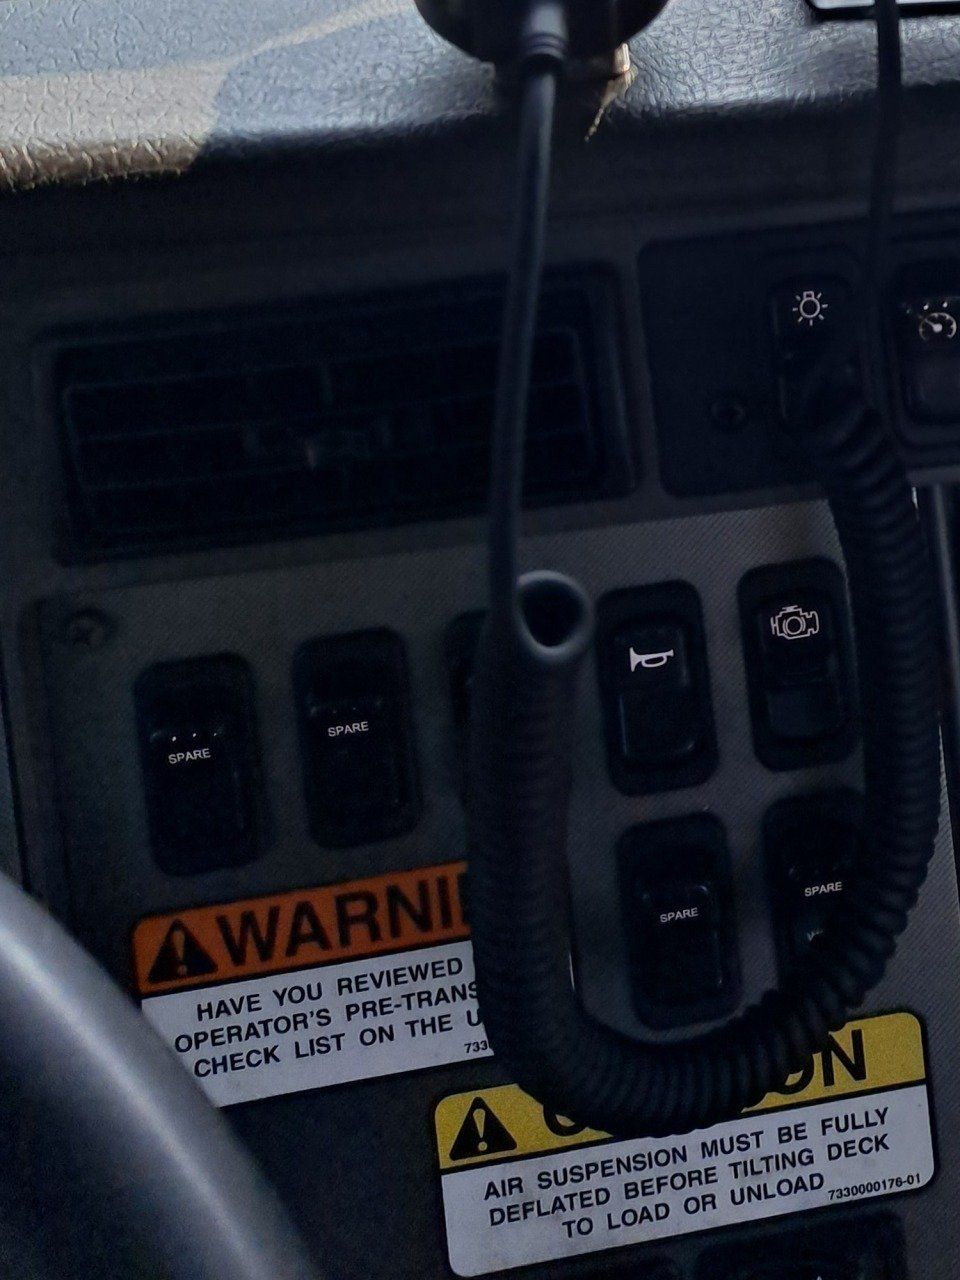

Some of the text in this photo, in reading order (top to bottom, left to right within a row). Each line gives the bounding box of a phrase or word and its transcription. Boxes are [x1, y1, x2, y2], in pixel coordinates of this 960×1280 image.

[327, 720, 370, 738] SPARE
[168, 747, 212, 765] SPARE
[804, 880, 843, 898] SPARE
[659, 906, 699, 923] SPARE
[196, 957, 464, 1021] HAVE YOU REVIEWED
[174, 1007, 333, 1054] OPERATOR'S
[193, 1045, 281, 1078] CHECK
[294, 1033, 346, 1060] LIST
[359, 1024, 396, 1047] ON
[405, 1014, 454, 1039] THE
[484, 1106, 889, 1202] AIR SUSPENSION MUST BE FULLY
[489, 1133, 890, 1228] DEFLATED BEFORE TILTING DECK
[828, 1172, 922, 1201] 7330000176-01
[562, 1172, 825, 1239] TO LOAD OR UNLOAD
